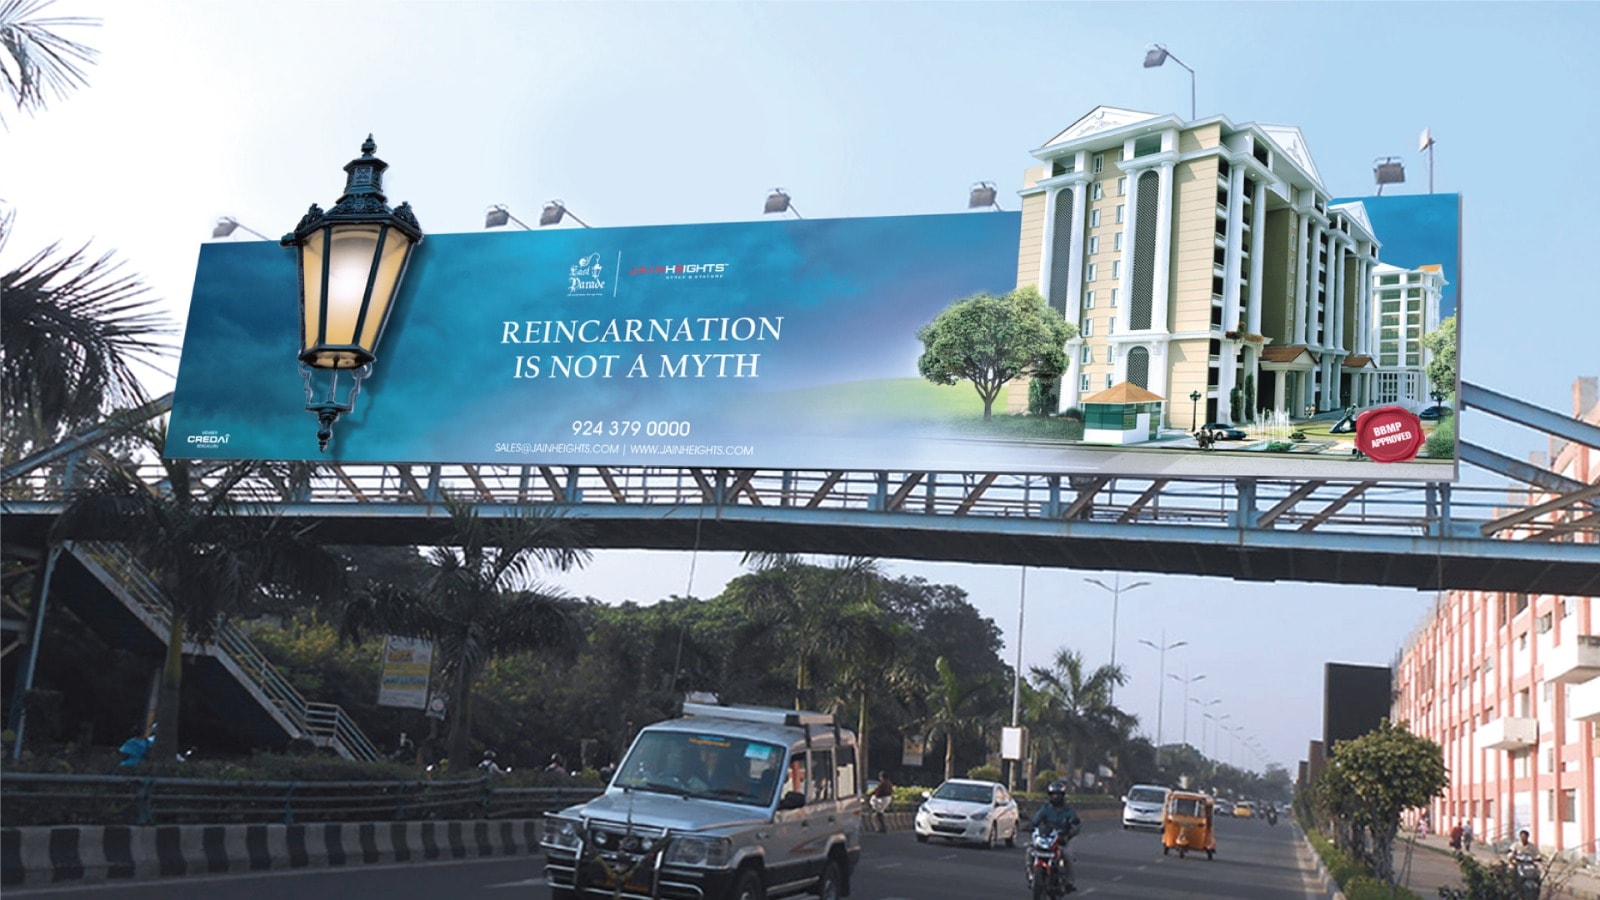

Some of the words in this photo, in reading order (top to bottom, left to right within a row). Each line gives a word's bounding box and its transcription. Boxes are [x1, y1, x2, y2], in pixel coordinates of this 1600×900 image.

[568, 277, 605, 293] Parade
[500, 316, 784, 344] REINCARNATION
[513, 355, 541, 379] IS
[548, 354, 621, 379] NOT
[626, 353, 649, 378] A
[658, 353, 761, 378] MYTH
[572, 420, 603, 436] 924
[608, 420, 642, 436] 379
[646, 421, 691, 437] 0000
[1373, 422, 1402, 437] BBMP
[187, 434, 231, 444] CREDAI
[1371, 431, 1412, 449] APPROVED
[494, 442, 620, 455] SALES@JAINHEIGHTS.COM
[630, 444, 754, 456] WWW.JAINHEIGHTS.COM
